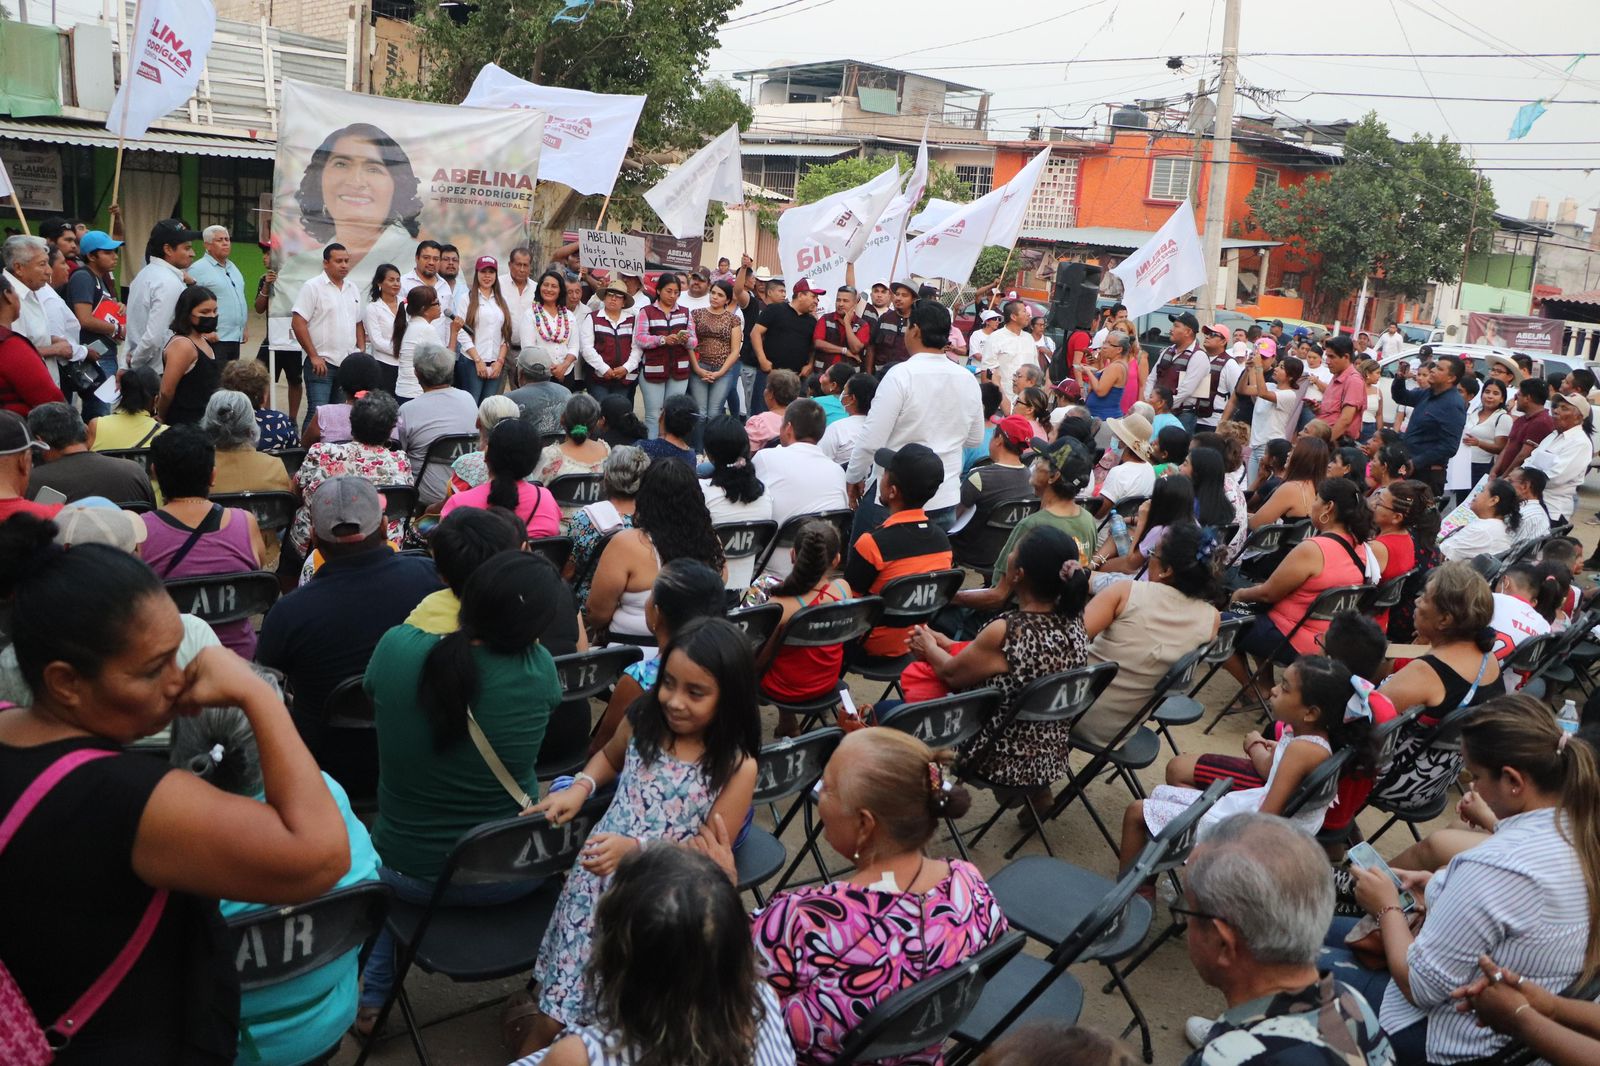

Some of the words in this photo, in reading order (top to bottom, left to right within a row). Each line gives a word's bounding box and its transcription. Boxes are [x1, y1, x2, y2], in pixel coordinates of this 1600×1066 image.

[150, 16, 192, 68] LINA
[431, 168, 533, 190] ABELINA
[431, 185, 467, 195] LÓPEZ
[469, 188, 533, 202] RODRÍGUEZ
[440, 197, 483, 206] PRESIDENTA
[484, 200, 522, 210] MUNICIPAL
[572, 481, 600, 501] AR
[727, 531, 756, 550] AR
[188, 584, 234, 615] AR
[902, 583, 938, 608] AR
[1050, 678, 1090, 710] AR
[912, 708, 963, 742] AR
[234, 914, 314, 972] AR
